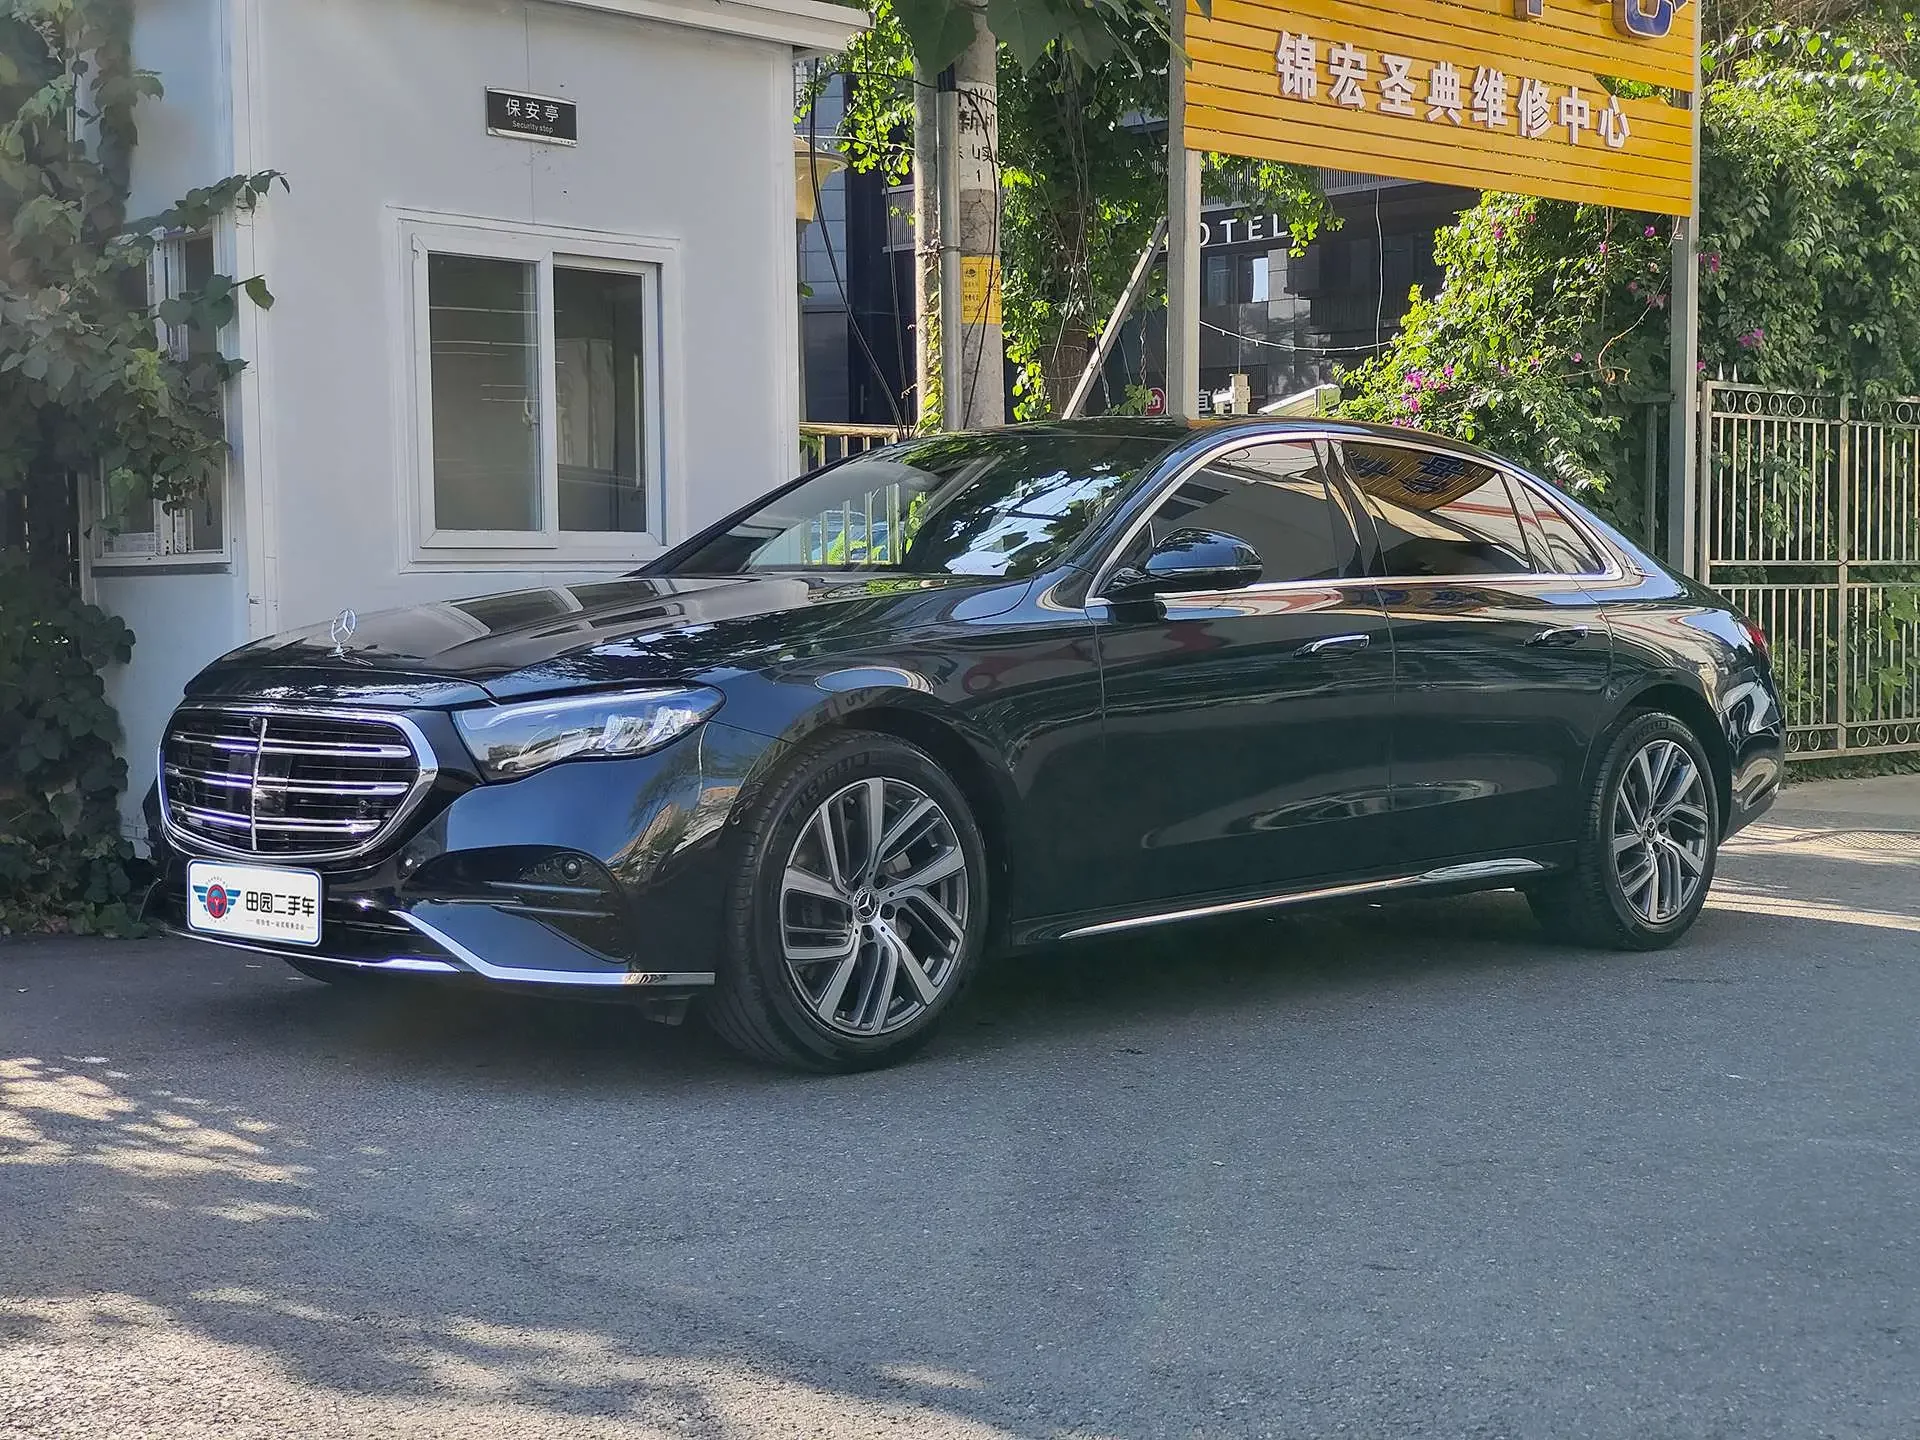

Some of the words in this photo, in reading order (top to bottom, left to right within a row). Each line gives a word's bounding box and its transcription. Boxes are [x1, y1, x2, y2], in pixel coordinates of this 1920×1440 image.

[1275, 30, 1631, 148] 锦宏圣典维修中心
[505, 97, 559, 122] 保安亭
[512, 120, 538, 132] Security
[246, 891, 315, 917] 田园二手车
